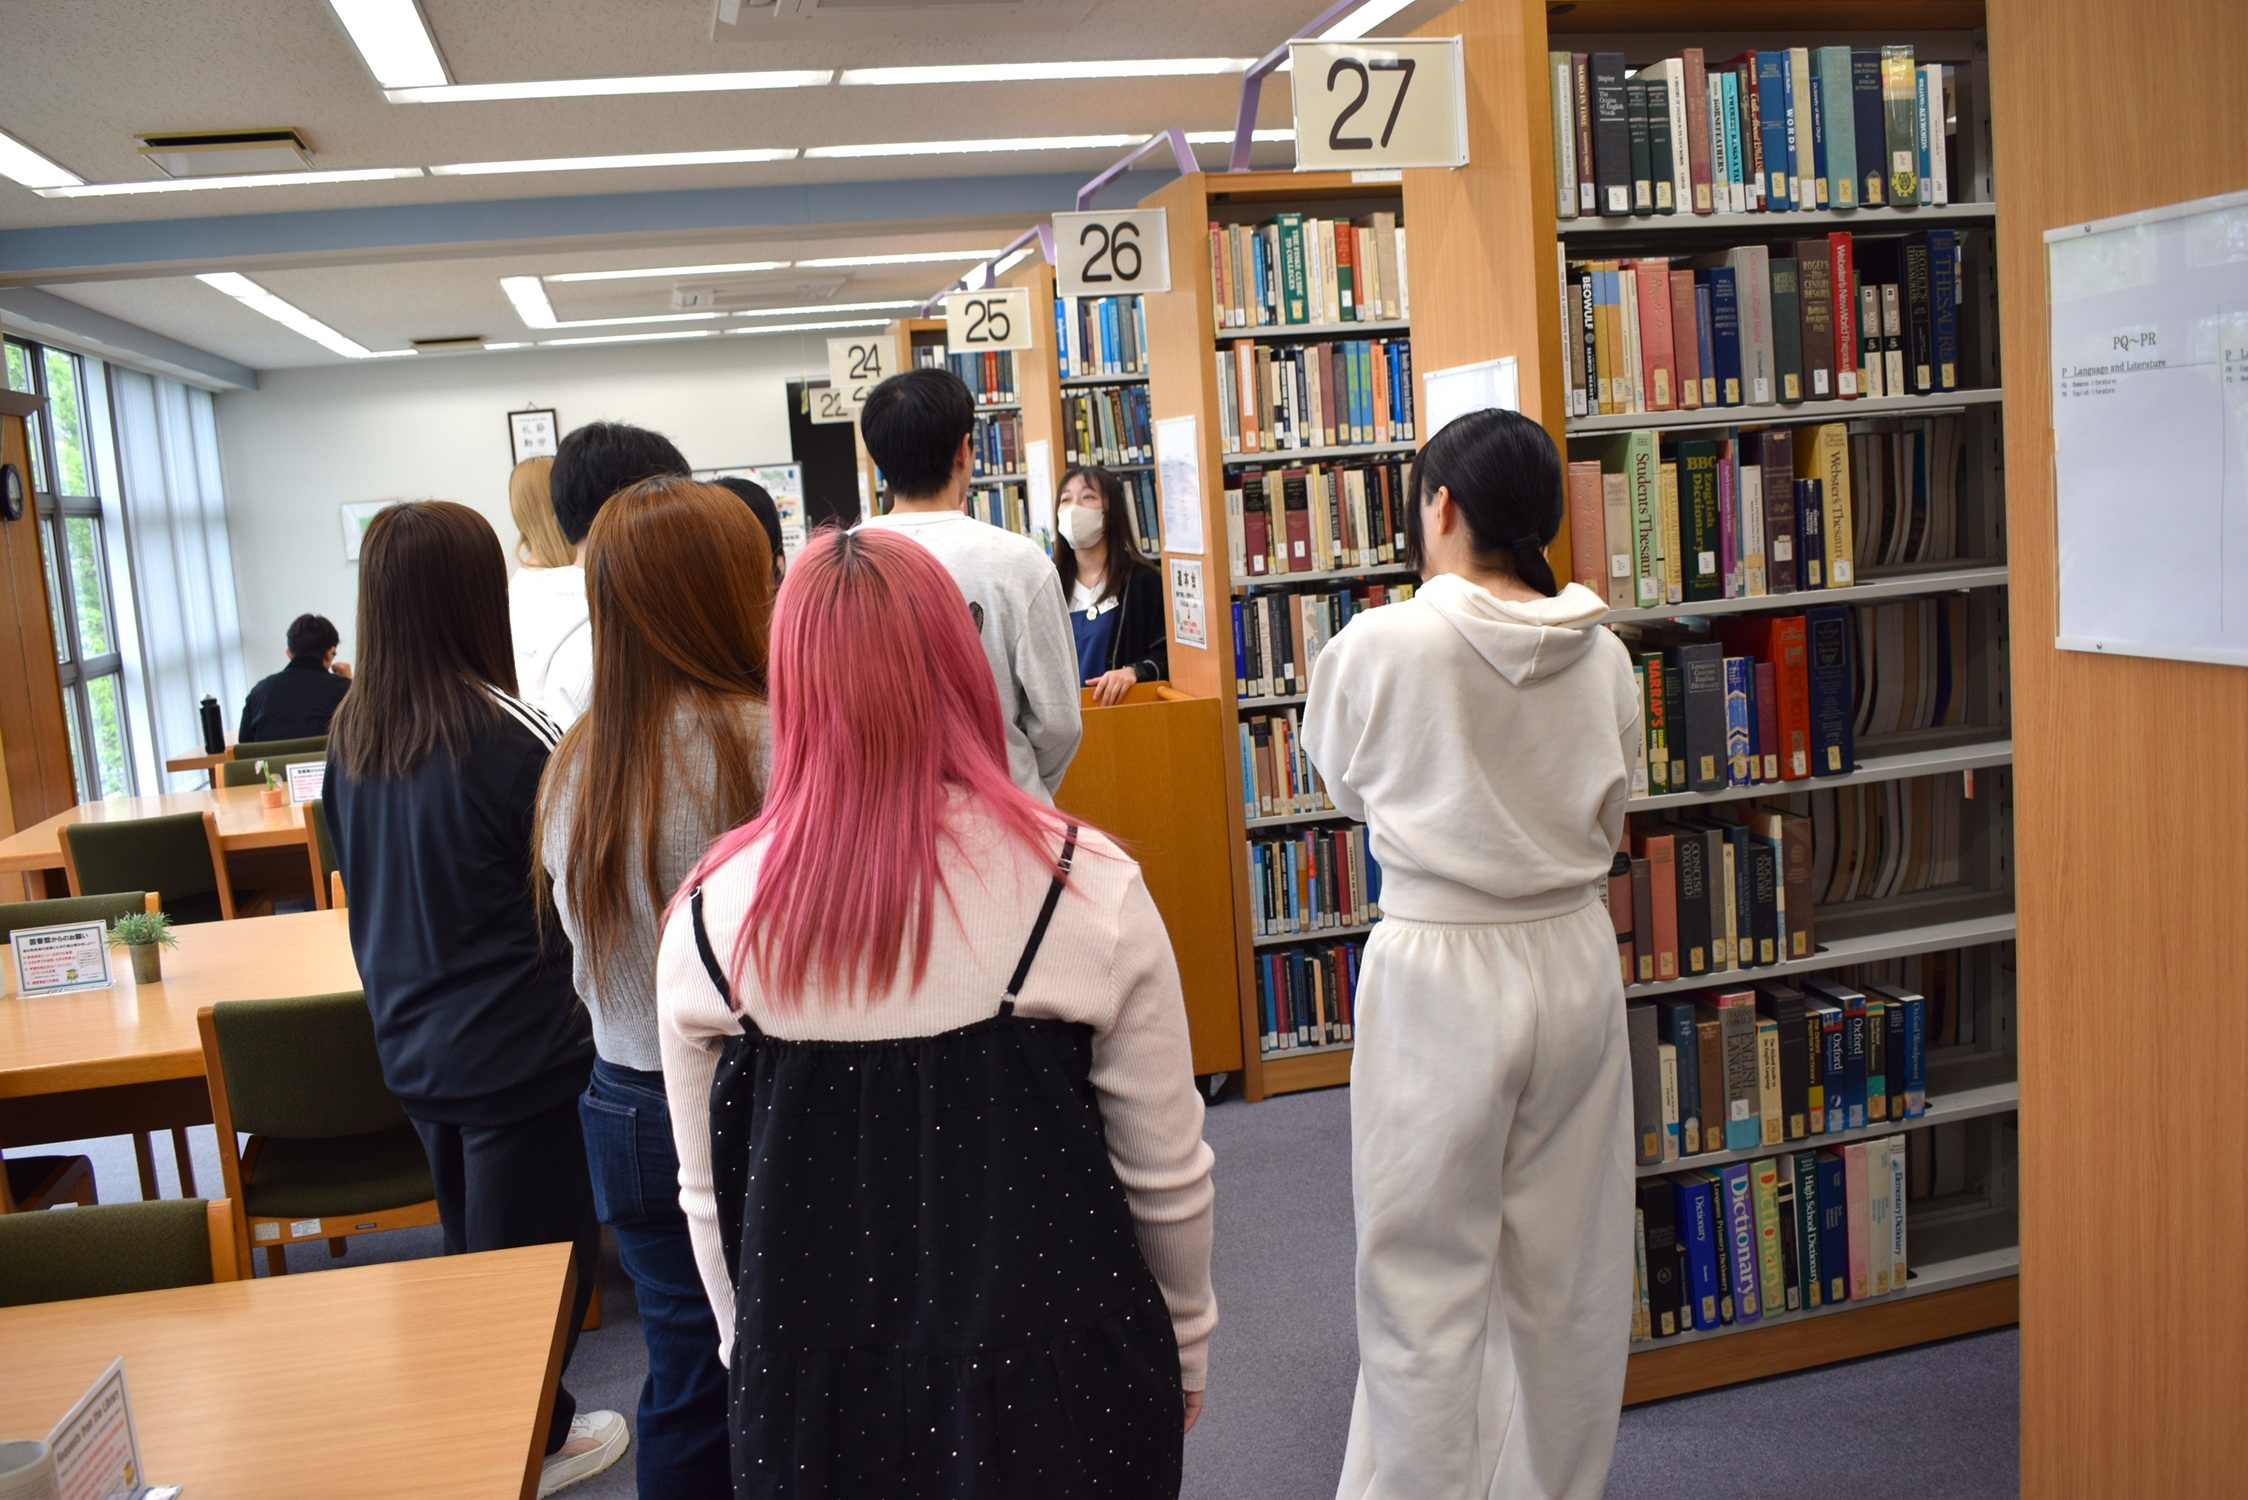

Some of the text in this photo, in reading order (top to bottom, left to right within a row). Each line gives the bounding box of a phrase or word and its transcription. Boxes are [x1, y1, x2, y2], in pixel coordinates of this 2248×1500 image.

[1577, 64, 1585, 93] WORDS
[1598, 75, 1614, 83] Shipley
[1327, 57, 1416, 149] 27
[1580, 95, 1585, 106] IN
[1713, 99, 1724, 173] HORSEFEATHERS
[1787, 108, 1795, 152] WORDS
[1080, 222, 1142, 283] 26
[1285, 237, 1295, 290] TO COLLEGES
[1803, 261, 1829, 270] ROGET'S
[1582, 276, 1593, 329] BEOWULF
[1649, 278, 1664, 312] Roget's
[1804, 280, 1828, 289] CENTURY
[1804, 290, 1829, 298] THESAURUS
[1837, 245, 1849, 334] Webster's New World
[964, 300, 1011, 342] 25
[1752, 298, 1760, 319] Right
[1936, 255, 1955, 363] THESAURU
[1753, 321, 1761, 343] Word
[2113, 332, 2156, 350] PQ~PR
[848, 343, 881, 379] 24
[2062, 360, 2166, 377] P Language and Literature
[2226, 350, 2231, 360] P
[2091, 378, 2116, 386] literatures
[821, 393, 848, 417] 22
[1635, 453, 1651, 514] Students
[1687, 456, 1716, 470] BBC
[1830, 451, 1842, 504] Webster's
[1578, 478, 1594, 514] Roget's
[1693, 473, 1704, 552] Dictionary
[1704, 472, 1715, 528] English
[1670, 491, 1680, 553] LEXICOGRAPHER'S
[1673, 554, 1681, 583] DILEMMA
[1648, 660, 1663, 727] HARRAP'S
[1682, 844, 1692, 895] OXFORD
[1692, 843, 1701, 894] CONCISE
[1756, 857, 1765, 900] OXFORD
[30, 934, 88, 945] 図書館からのお願い
[1726, 1010, 1751, 1018] COLLINS
[1833, 1033, 1842, 1070] Oxford
[1854, 1018, 1863, 1055] Oxford
[1912, 1033, 1920, 1080] Wordpower
[1741, 1032, 1756, 1088] ENGLISH
[1695, 1196, 1705, 1241] Dictionary
[1731, 1175, 1755, 1295] Dictionary
[1758, 1169, 1780, 1288] Dictionary
[1804, 1175, 1818, 1283] High School Dictionary
[1895, 1216, 1903, 1255] Dictionary
[1720, 1254, 1728, 1292] Dictionary
[81, 1419, 93, 1437] from
[93, 1409, 102, 1423] the
[102, 1389, 119, 1412] Library
